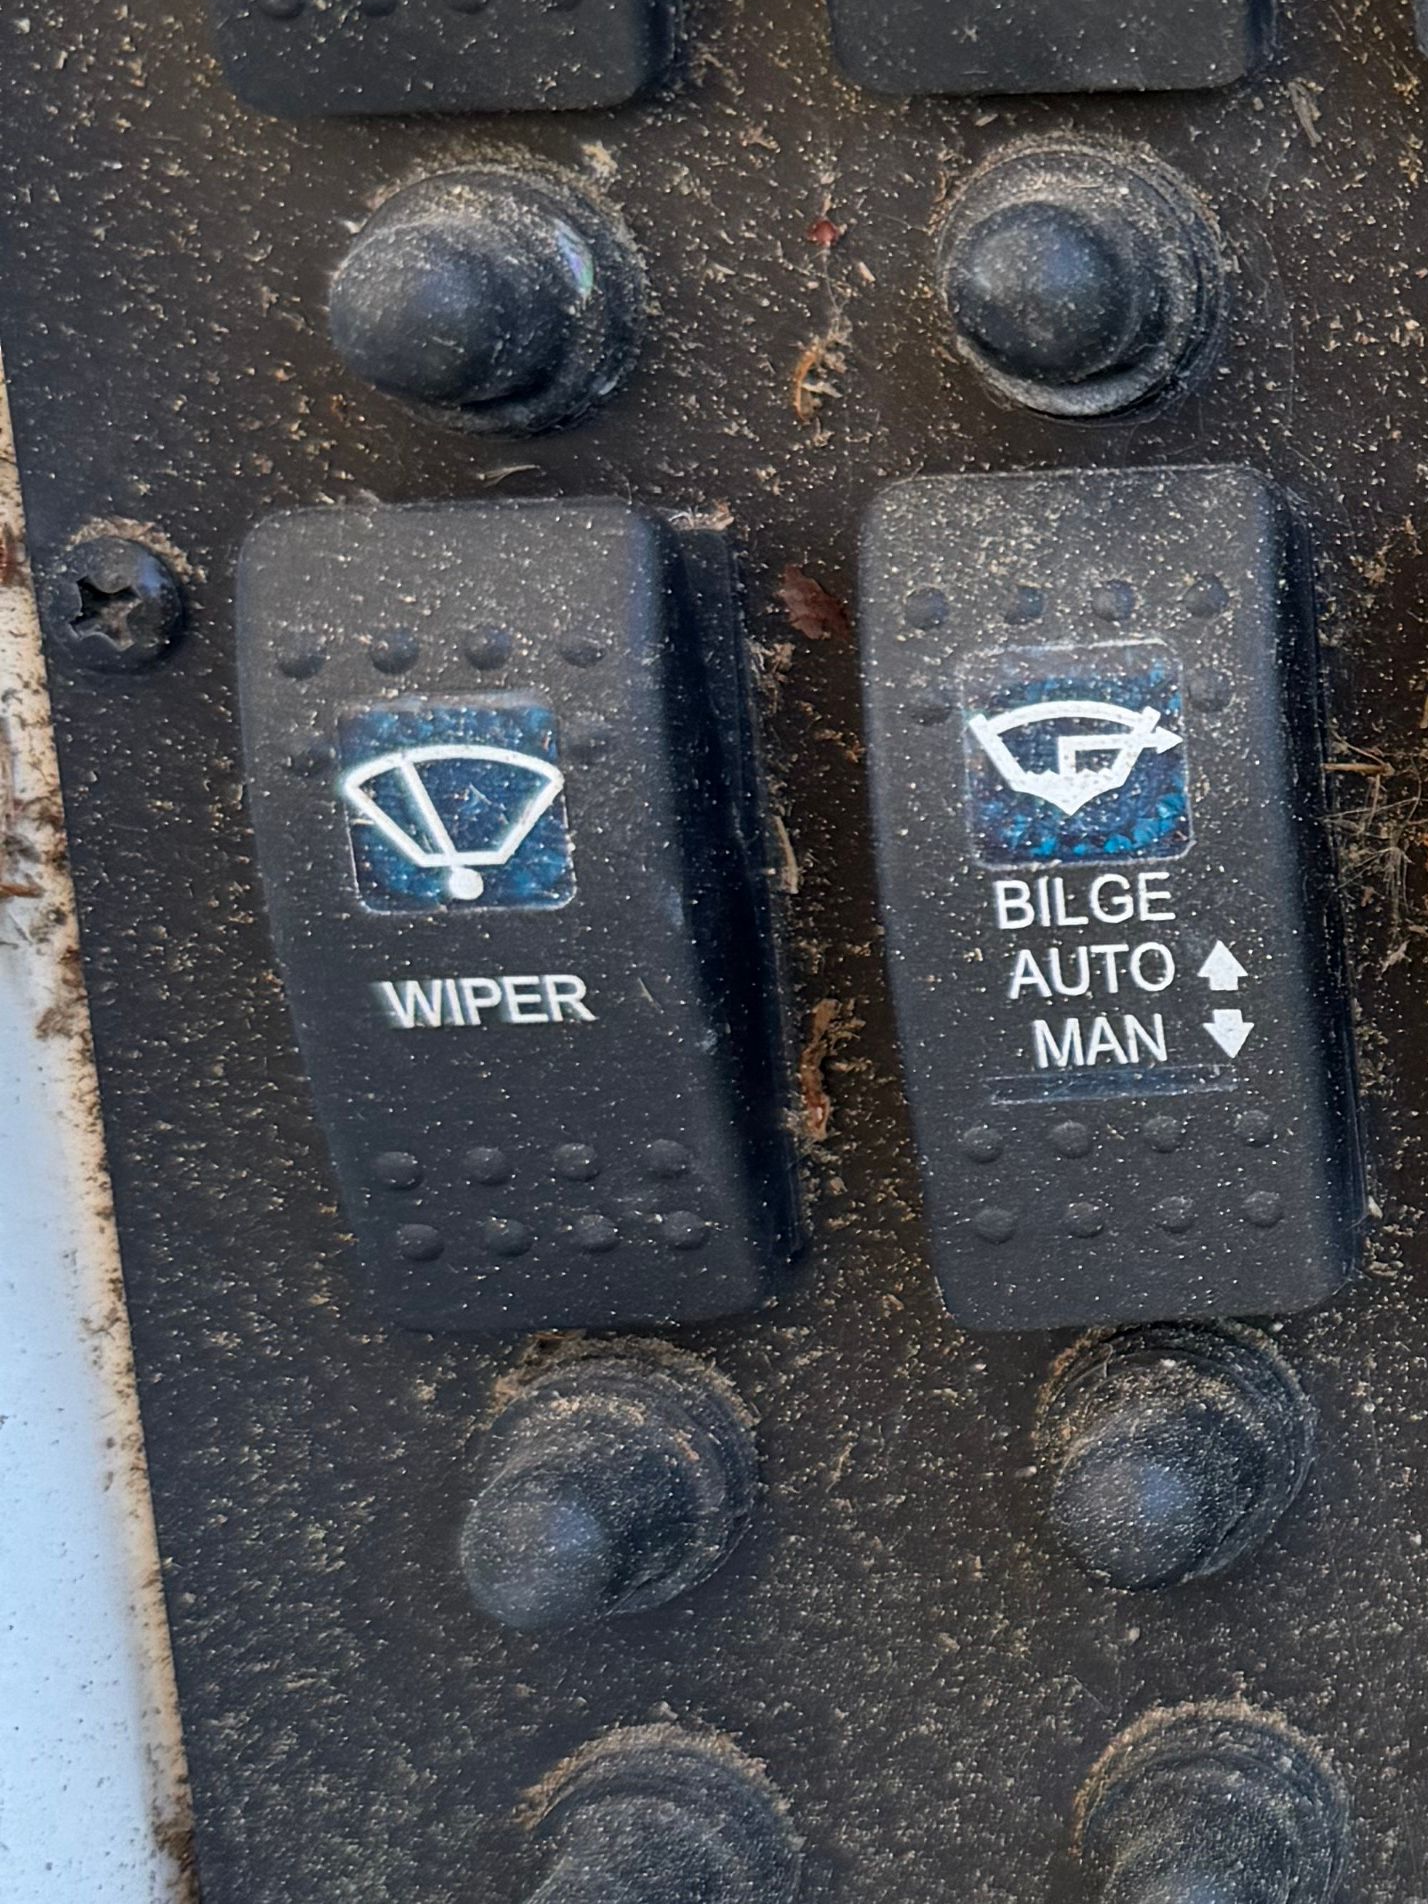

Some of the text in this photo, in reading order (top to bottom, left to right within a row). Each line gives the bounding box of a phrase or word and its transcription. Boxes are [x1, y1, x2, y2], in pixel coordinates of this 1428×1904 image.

[994, 869, 1175, 927] BILGE
[1008, 942, 1175, 1001] AUTO
[384, 974, 595, 1029] WIPER
[1032, 1015, 1170, 1067] MAN
